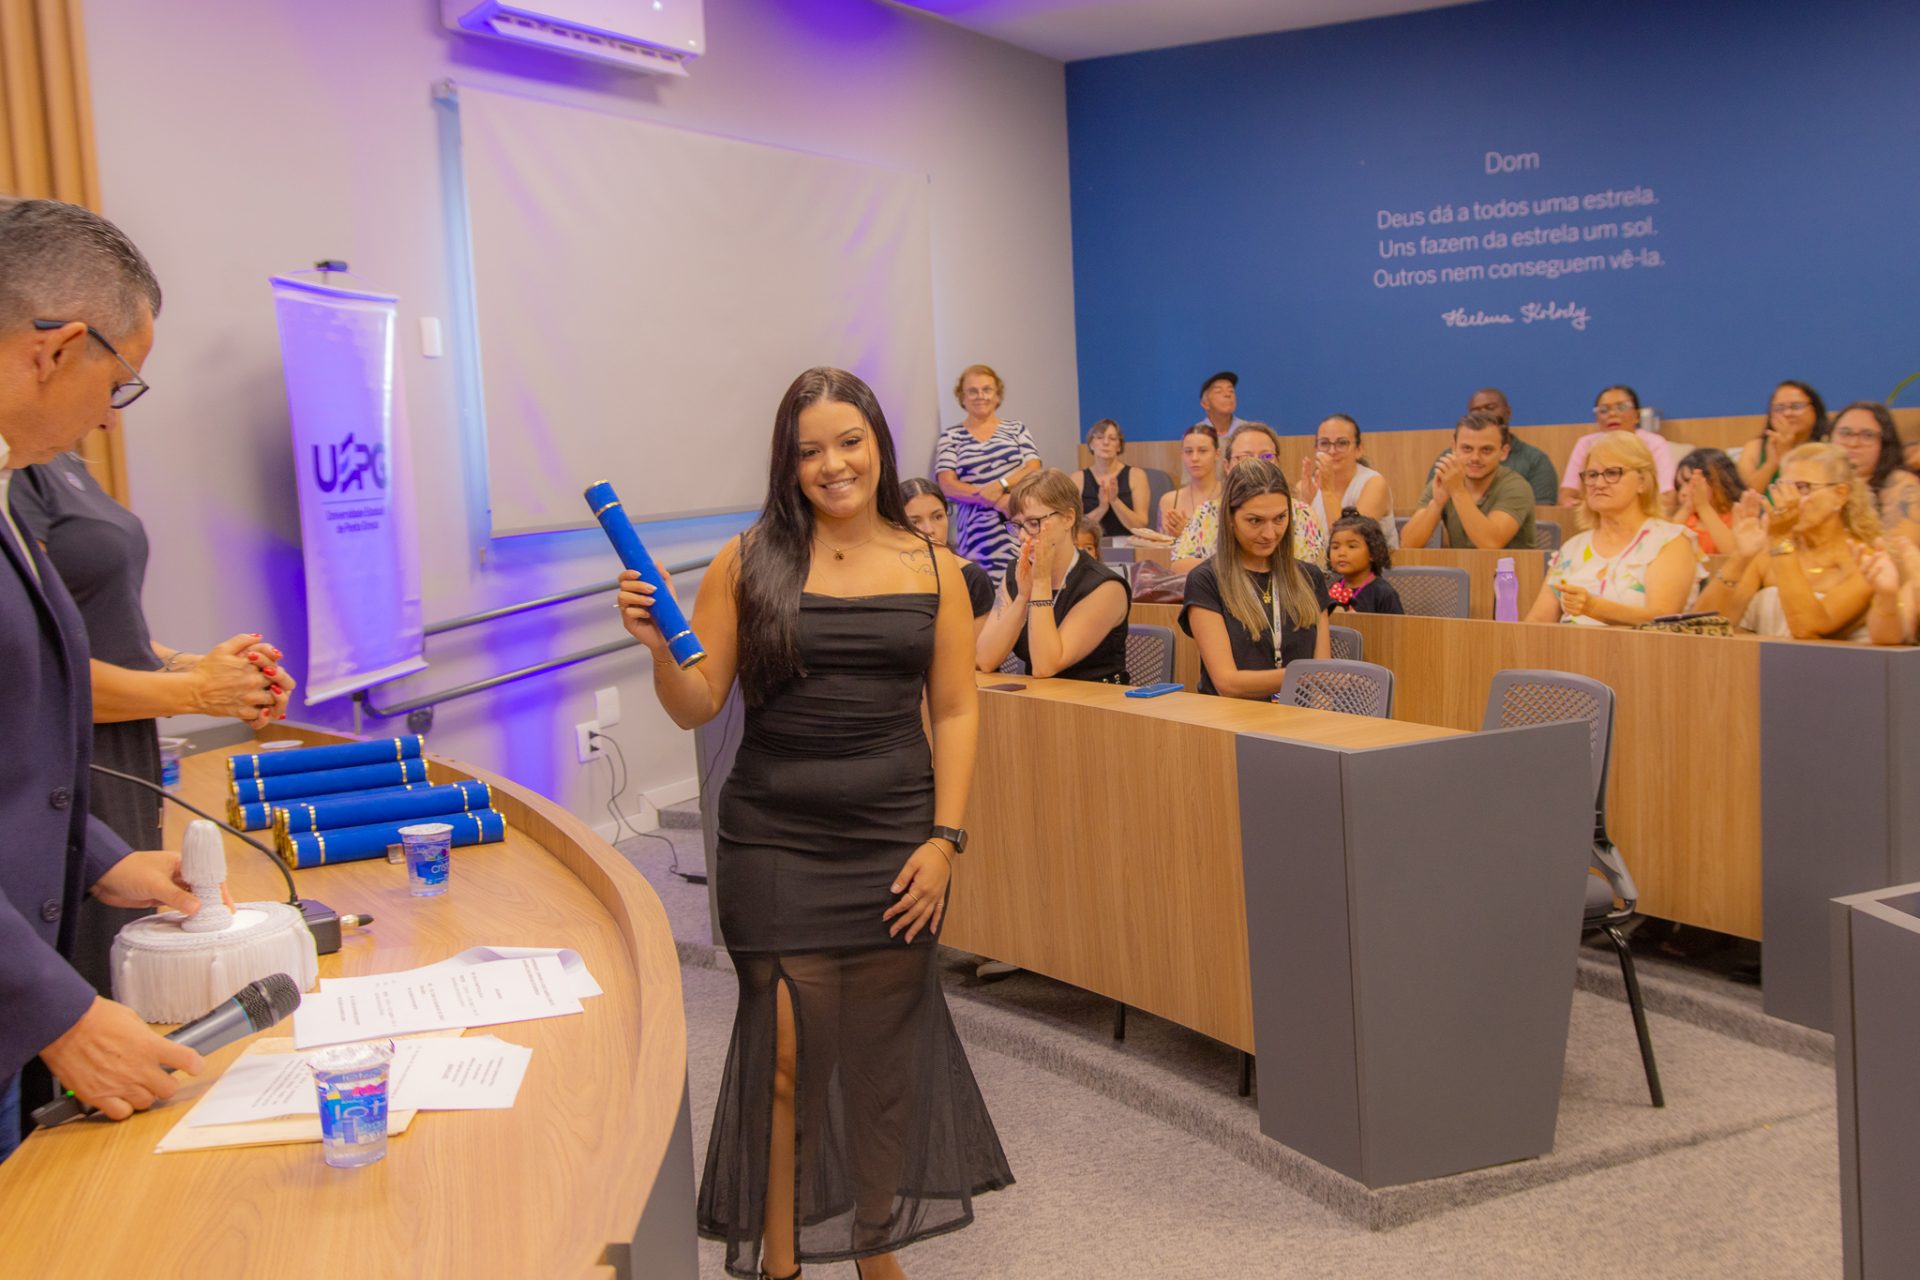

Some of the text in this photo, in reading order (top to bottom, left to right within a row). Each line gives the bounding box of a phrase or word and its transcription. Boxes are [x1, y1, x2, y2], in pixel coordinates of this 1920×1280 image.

[1485, 152, 1540, 174] Dom
[1377, 186, 1660, 231] Deus dá a todos uma estrela.
[1379, 216, 1658, 259] Uns fazem da estrela um sol.
[1373, 248, 1666, 288] Outros nem conseguem vê-la.
